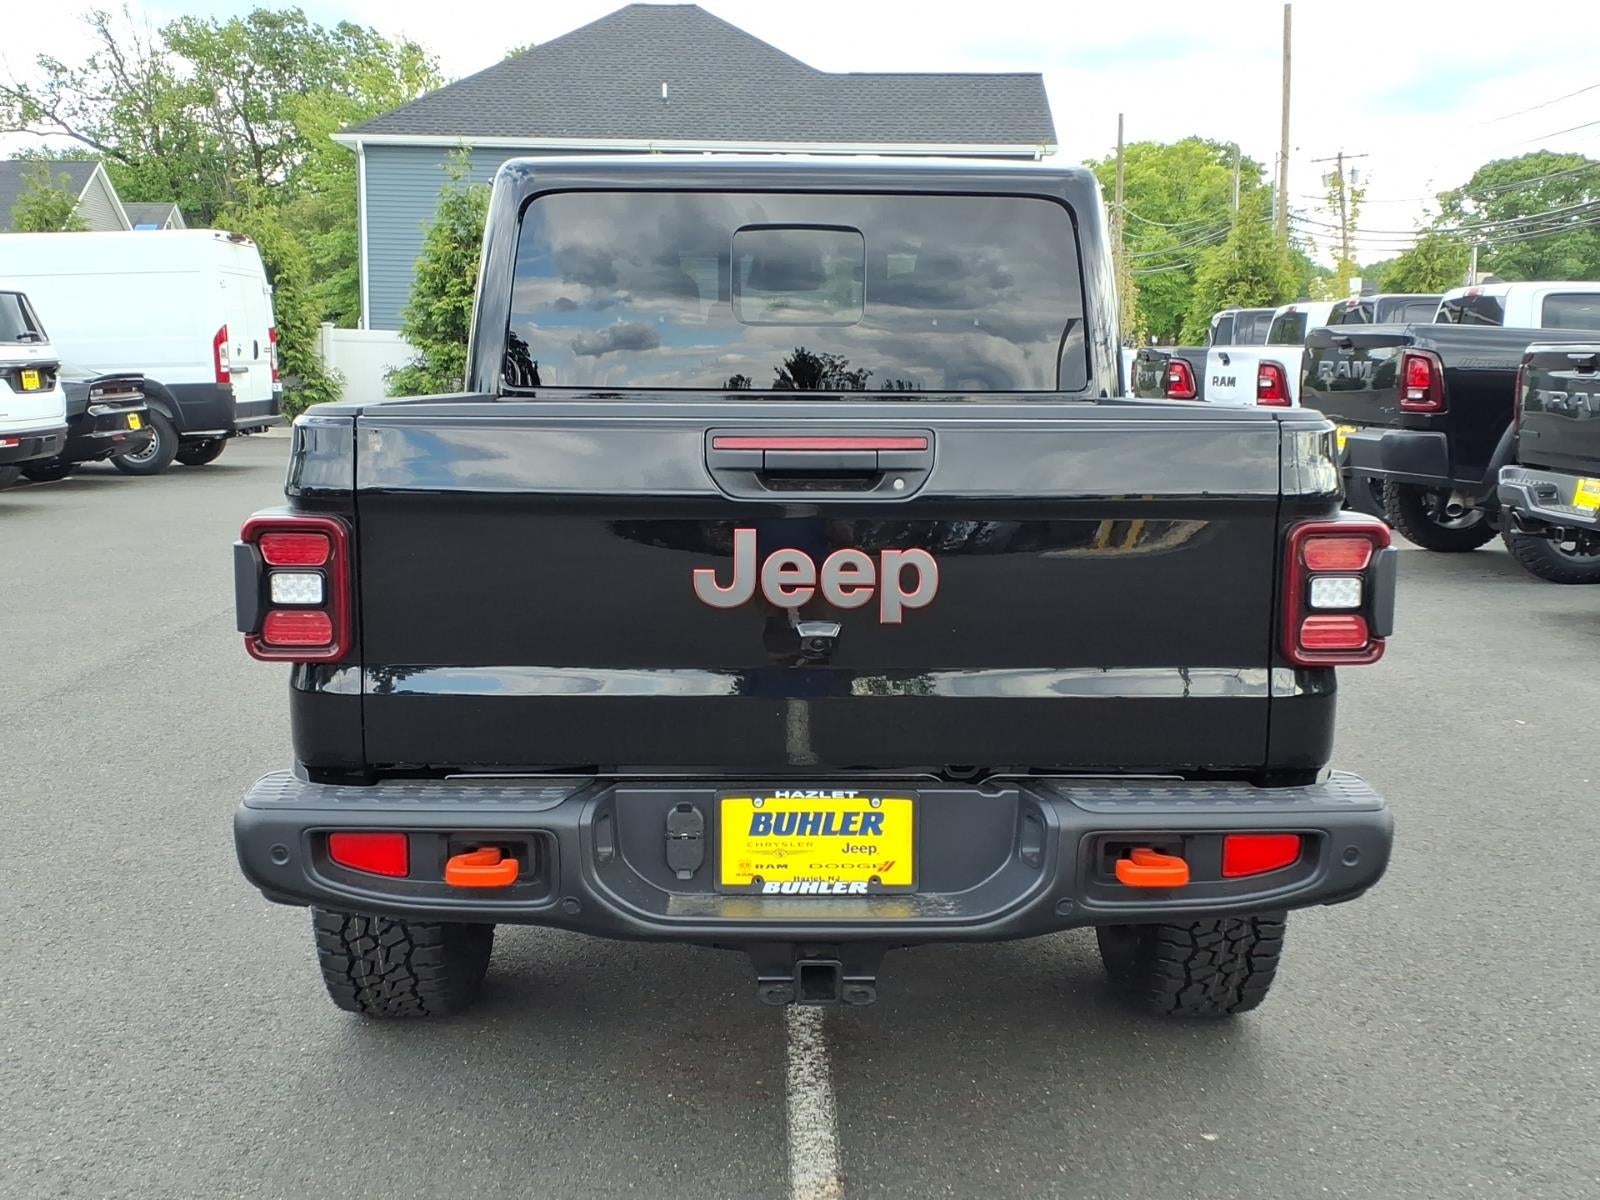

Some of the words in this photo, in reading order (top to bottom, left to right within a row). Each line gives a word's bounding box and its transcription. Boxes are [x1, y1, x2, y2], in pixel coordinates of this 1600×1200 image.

[1318, 361, 1373, 379] RAM
[1212, 376, 1236, 387] RAM
[693, 528, 939, 623] Jeep
[775, 791, 859, 799] HAZLET
[748, 812, 885, 836] BUHLER
[842, 842, 877, 855] Jeep
[762, 881, 868, 894] BUHLER
